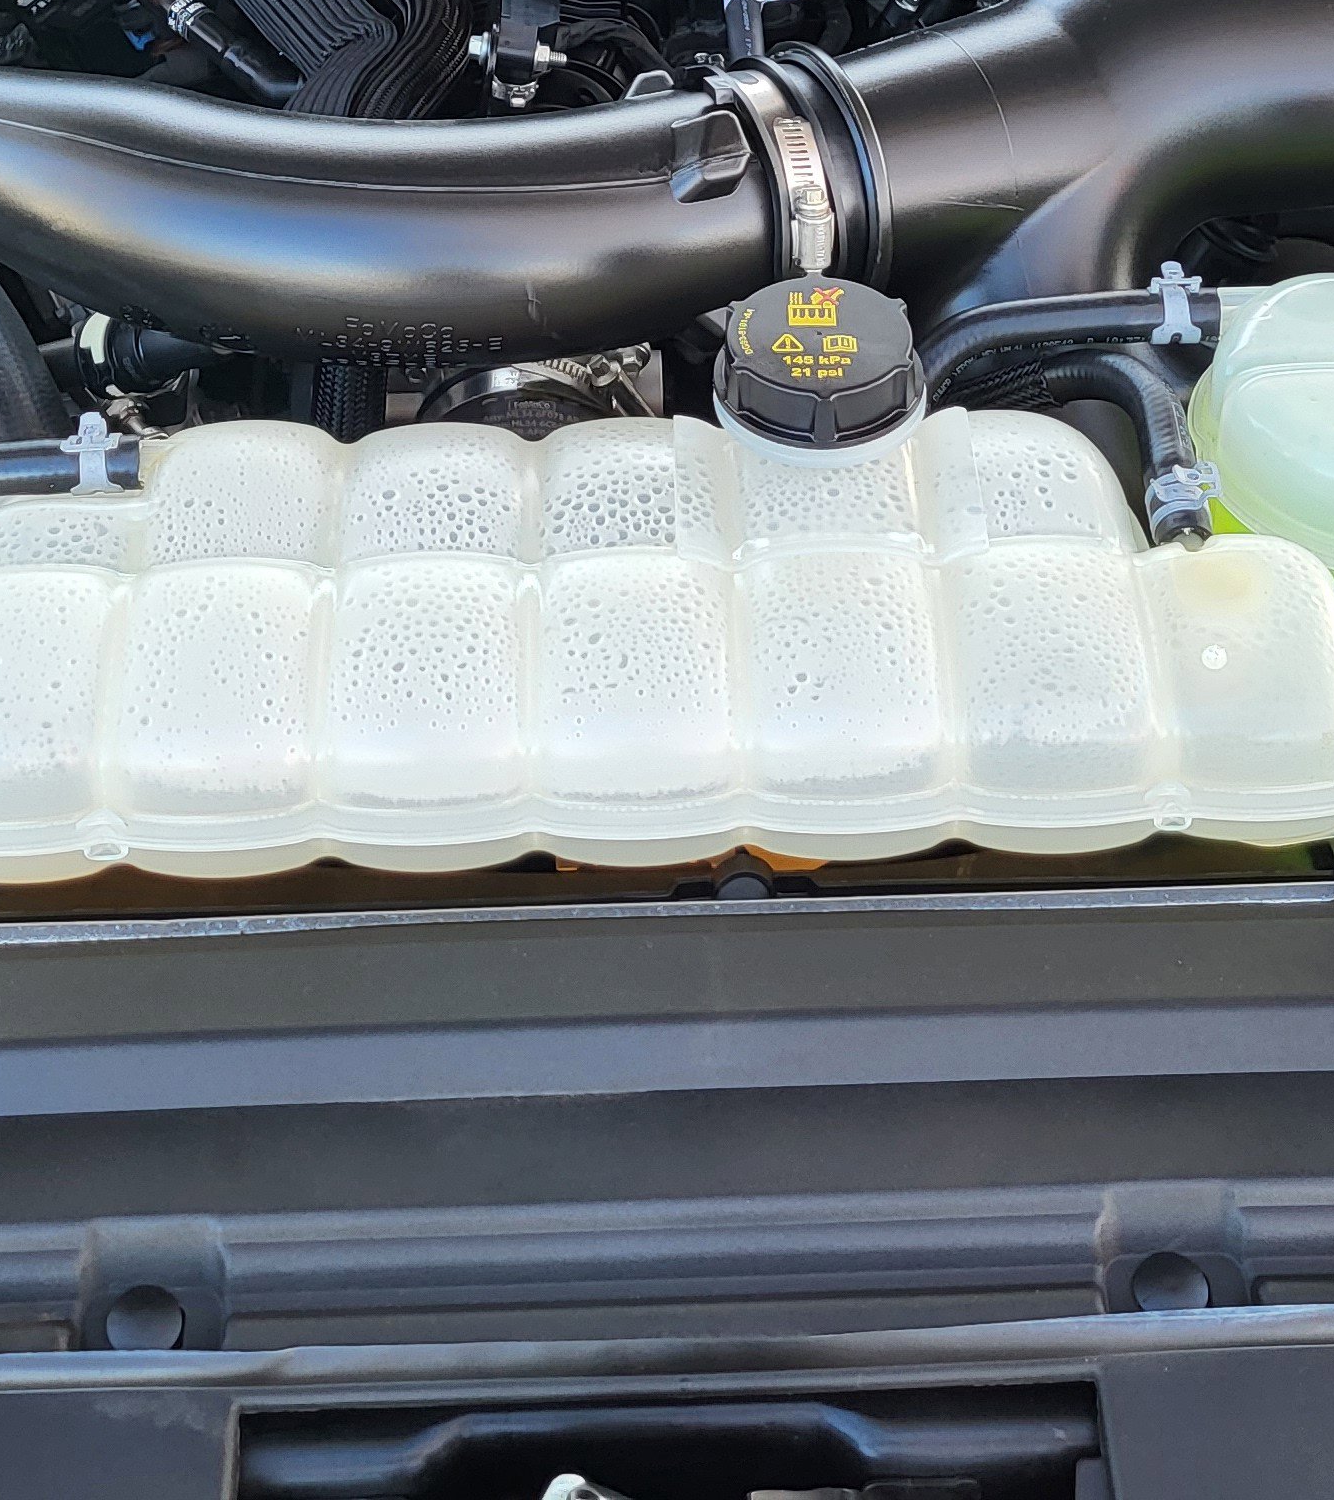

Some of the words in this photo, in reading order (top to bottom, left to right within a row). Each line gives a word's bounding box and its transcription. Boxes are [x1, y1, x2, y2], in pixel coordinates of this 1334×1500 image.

[781, 355, 814, 366] 145
[818, 355, 852, 366] kPa
[790, 367, 811, 378] 21
[817, 366, 844, 379] psi
